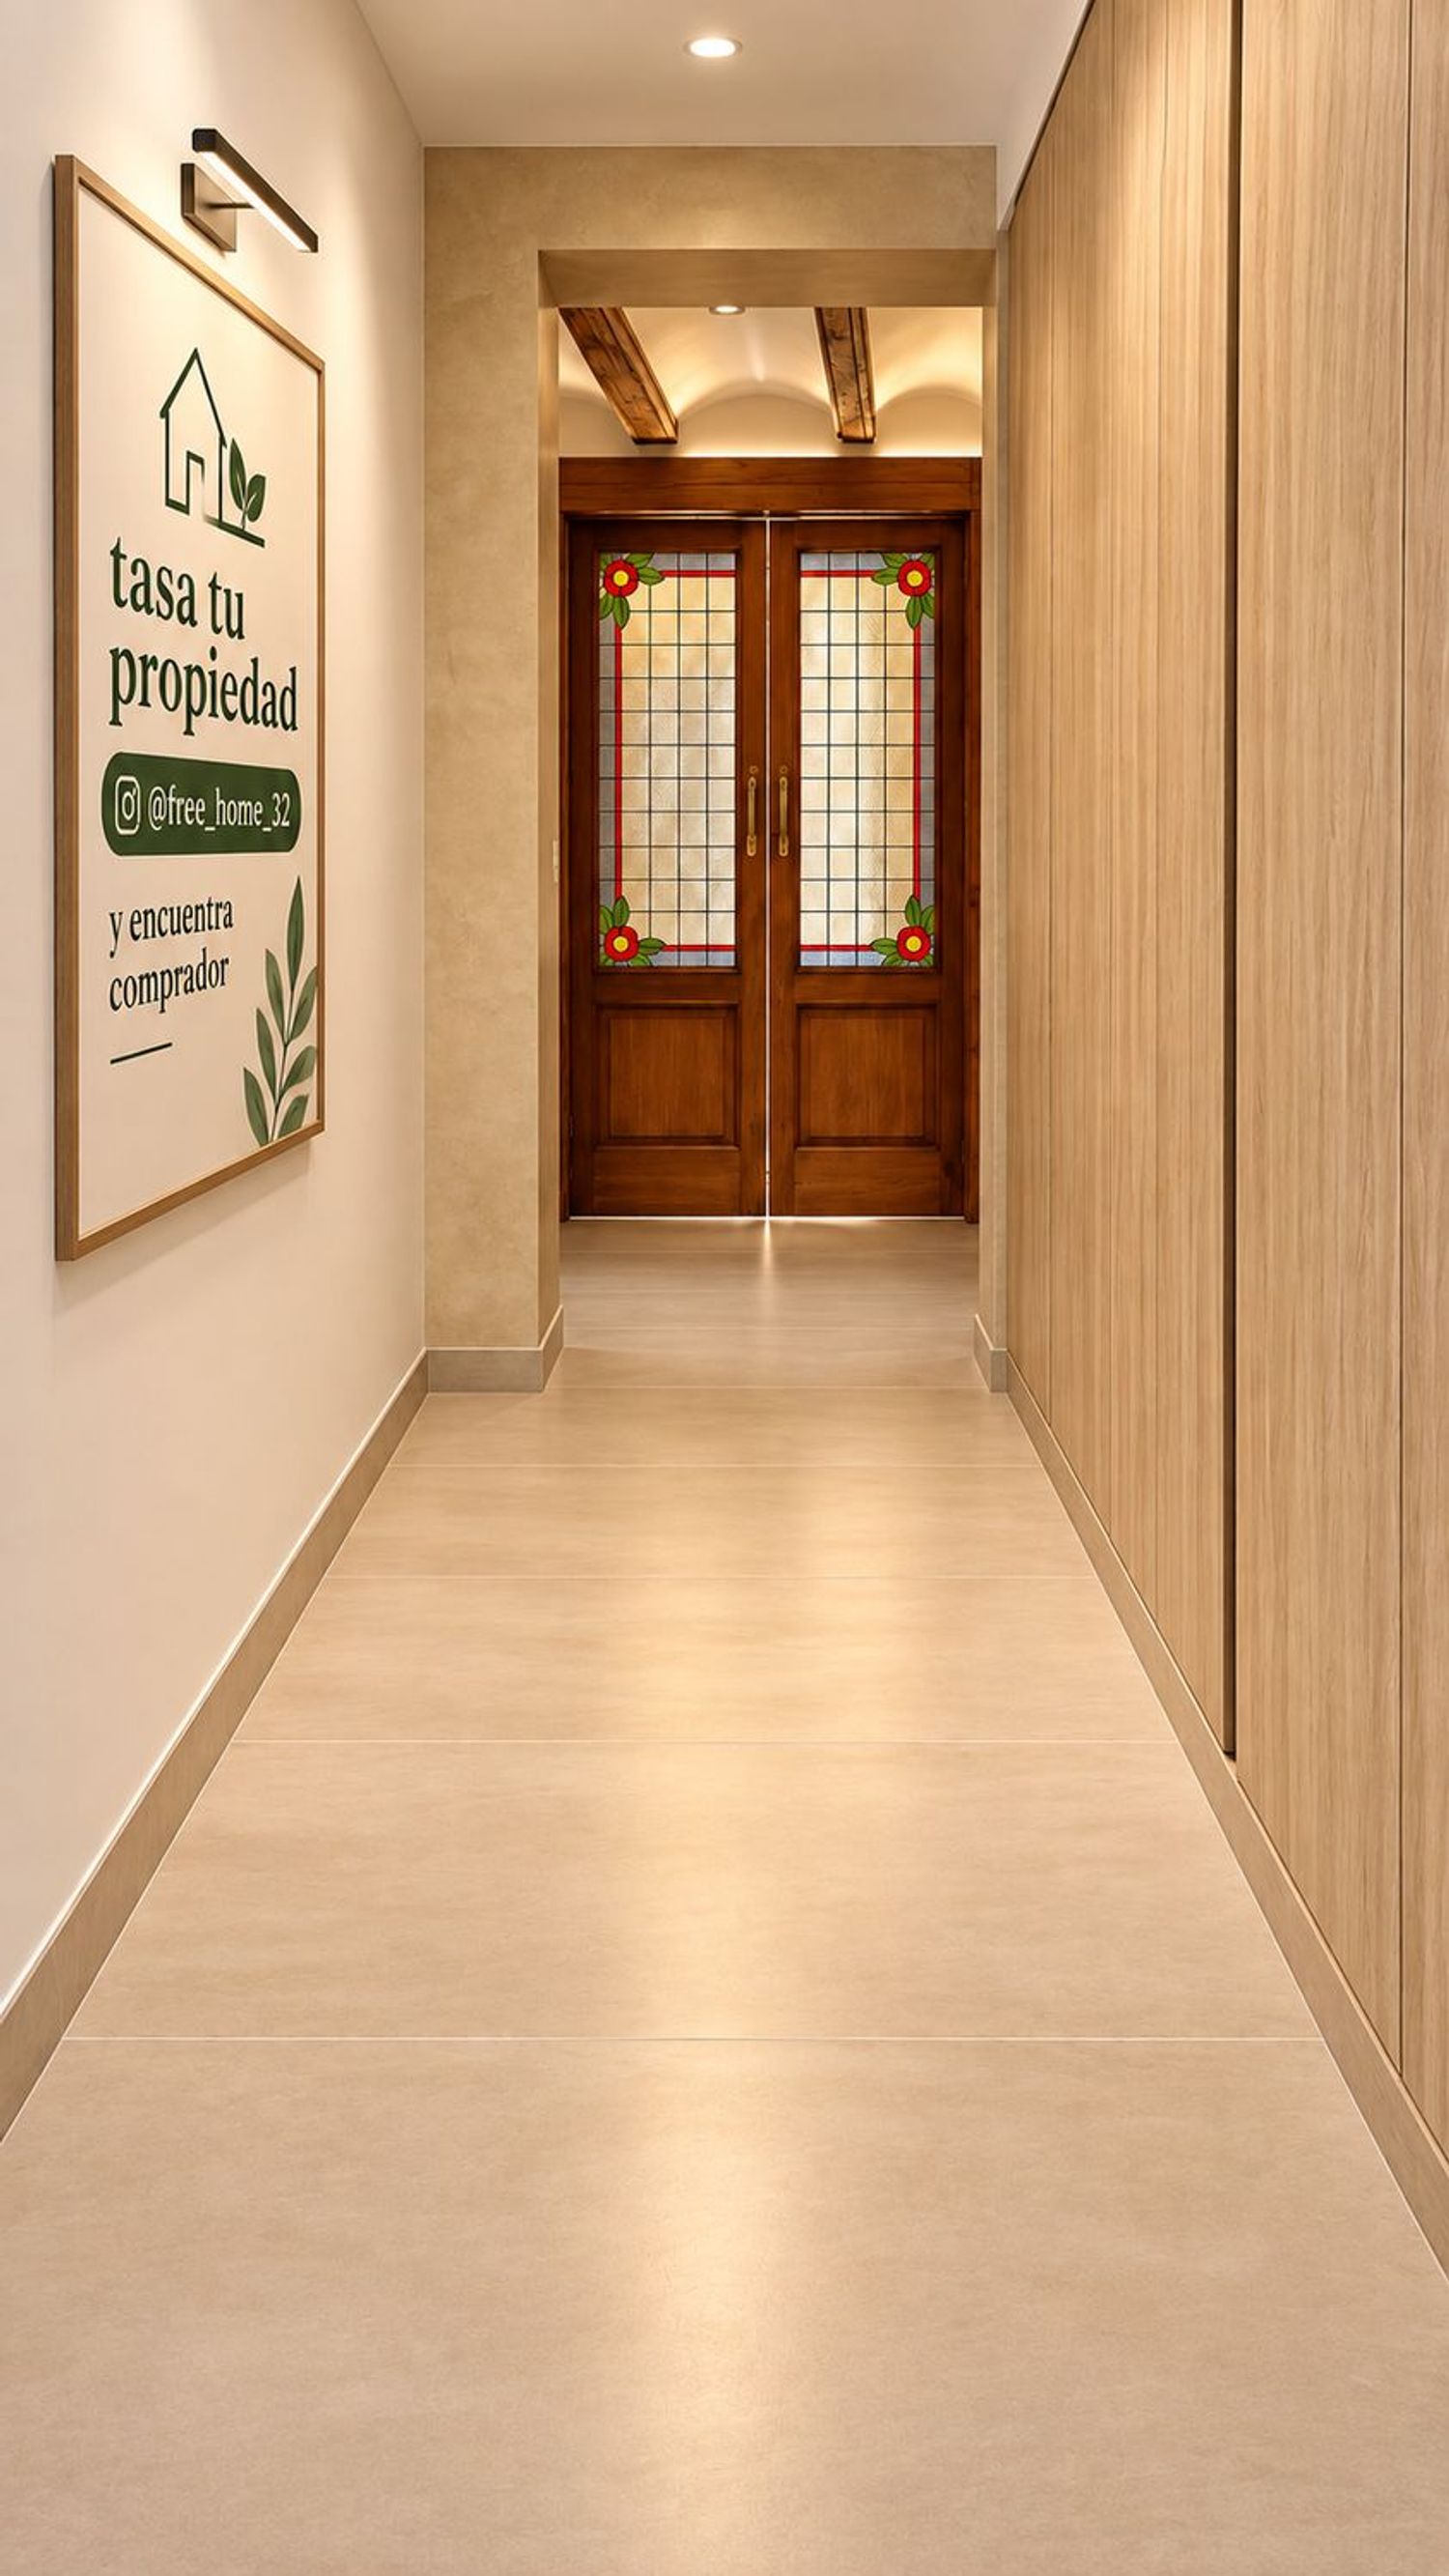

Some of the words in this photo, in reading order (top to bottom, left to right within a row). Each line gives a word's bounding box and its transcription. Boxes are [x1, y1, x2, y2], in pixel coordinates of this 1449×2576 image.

[109, 537, 199, 629] tasa
[209, 571, 246, 642] tu
[108, 645, 299, 737] propiedad
[148, 784, 291, 832] @free_home_32
[109, 910, 124, 959] y
[128, 897, 235, 942] encuentra
[109, 946, 231, 1016] comprador
